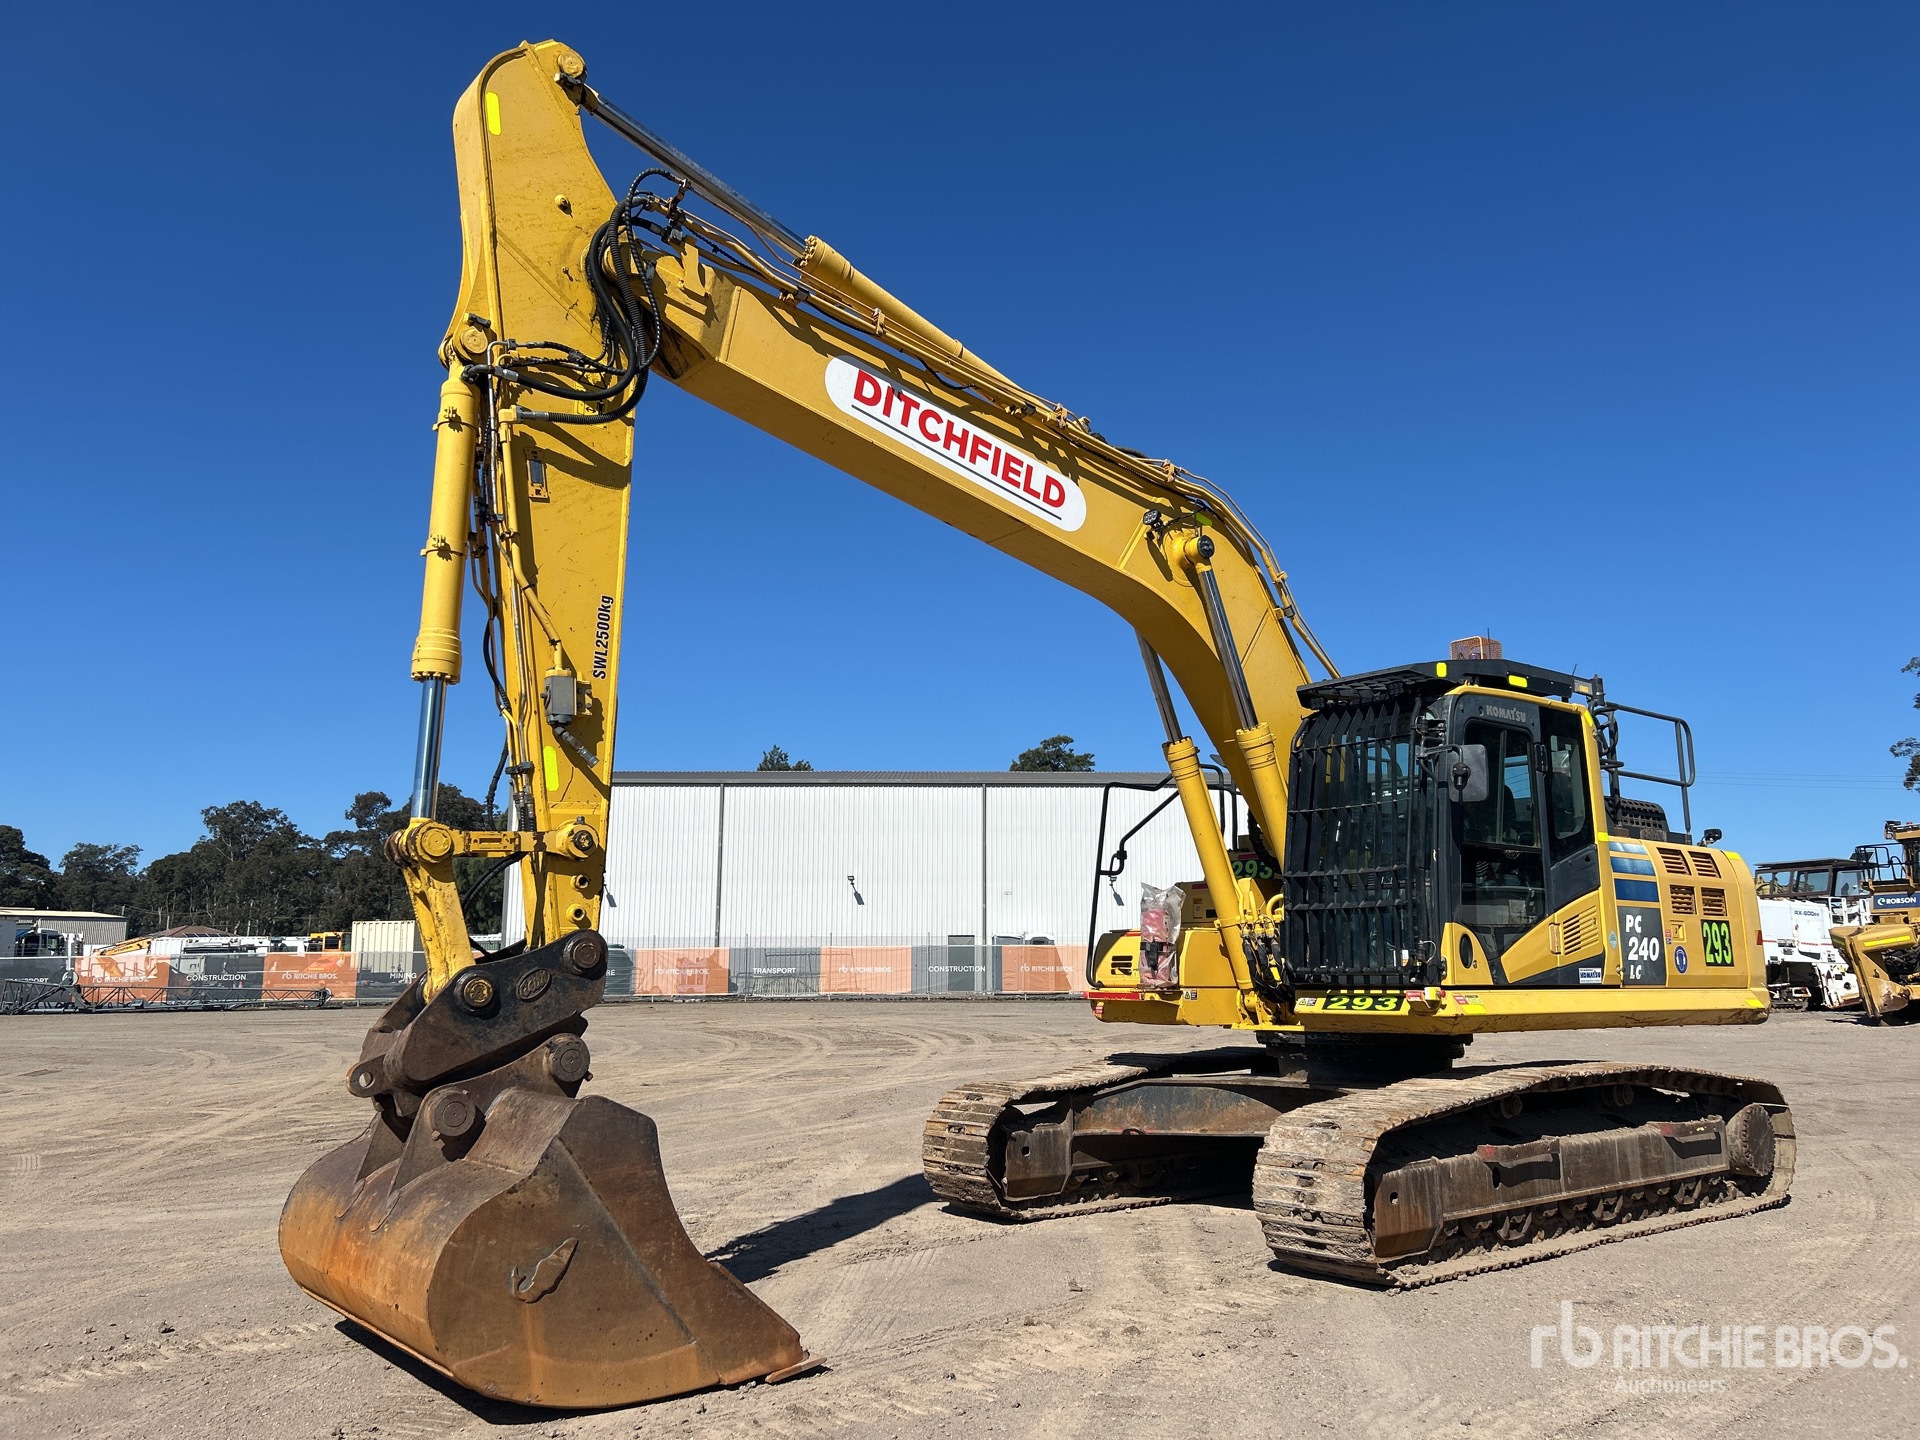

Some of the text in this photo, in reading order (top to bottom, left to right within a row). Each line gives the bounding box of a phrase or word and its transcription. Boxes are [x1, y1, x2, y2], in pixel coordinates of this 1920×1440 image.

[853, 368, 1066, 508] DITCHFIELD
[592, 595, 614, 680] SWL2500kg
[1486, 704, 1527, 723] KOMATSU
[1232, 859, 1273, 879] 293
[1886, 896, 1917, 906] ROBSON
[1625, 914, 1643, 934] PC
[1627, 936, 1660, 962] 240
[1702, 921, 1733, 965] 293
[185, 974, 247, 982] CONSTRUCTION
[318, 972, 338, 980] BROS.
[928, 965, 986, 973] CONSTRUCTION
[1629, 964, 1642, 980] LC
[1326, 995, 1399, 1011] 293
